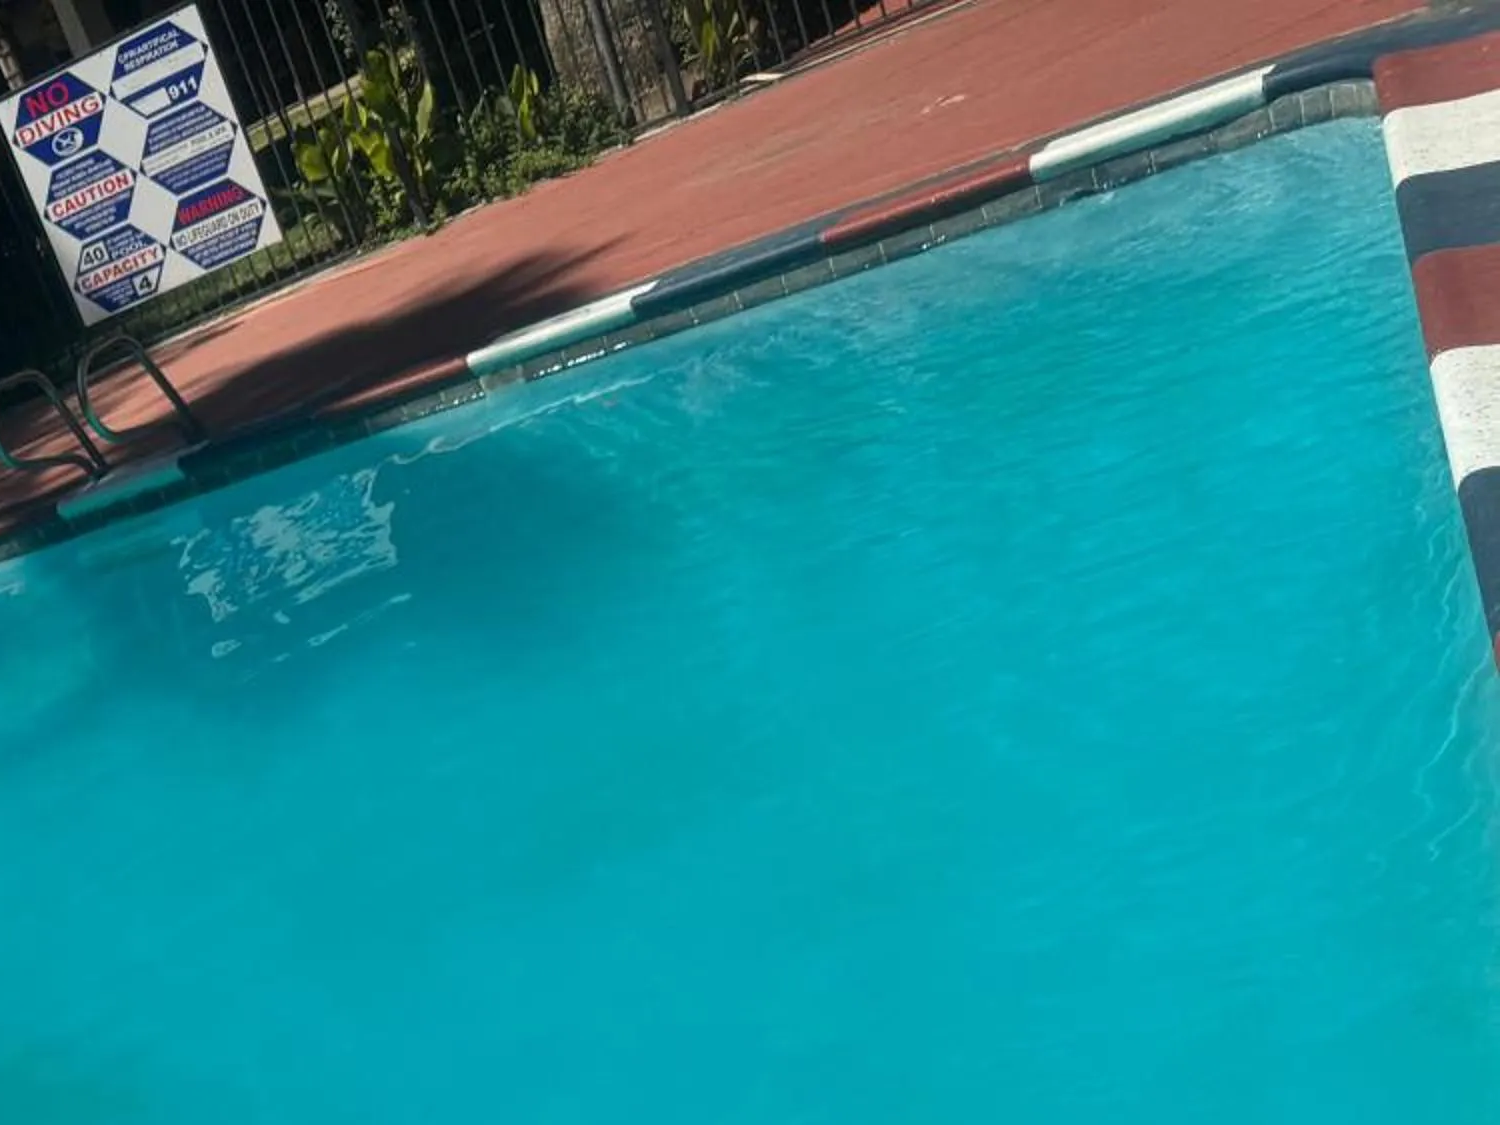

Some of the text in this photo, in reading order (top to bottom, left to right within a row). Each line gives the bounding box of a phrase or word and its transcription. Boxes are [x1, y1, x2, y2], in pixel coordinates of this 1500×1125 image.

[25, 82, 69, 118] NO
[168, 75, 197, 99] 911
[18, 95, 99, 145] DIVING
[52, 173, 129, 217] CAUTION
[178, 185, 245, 225] WARNING
[80, 247, 159, 290] CAPACITY
[83, 247, 105, 266] 40
[137, 275, 152, 290] 4
